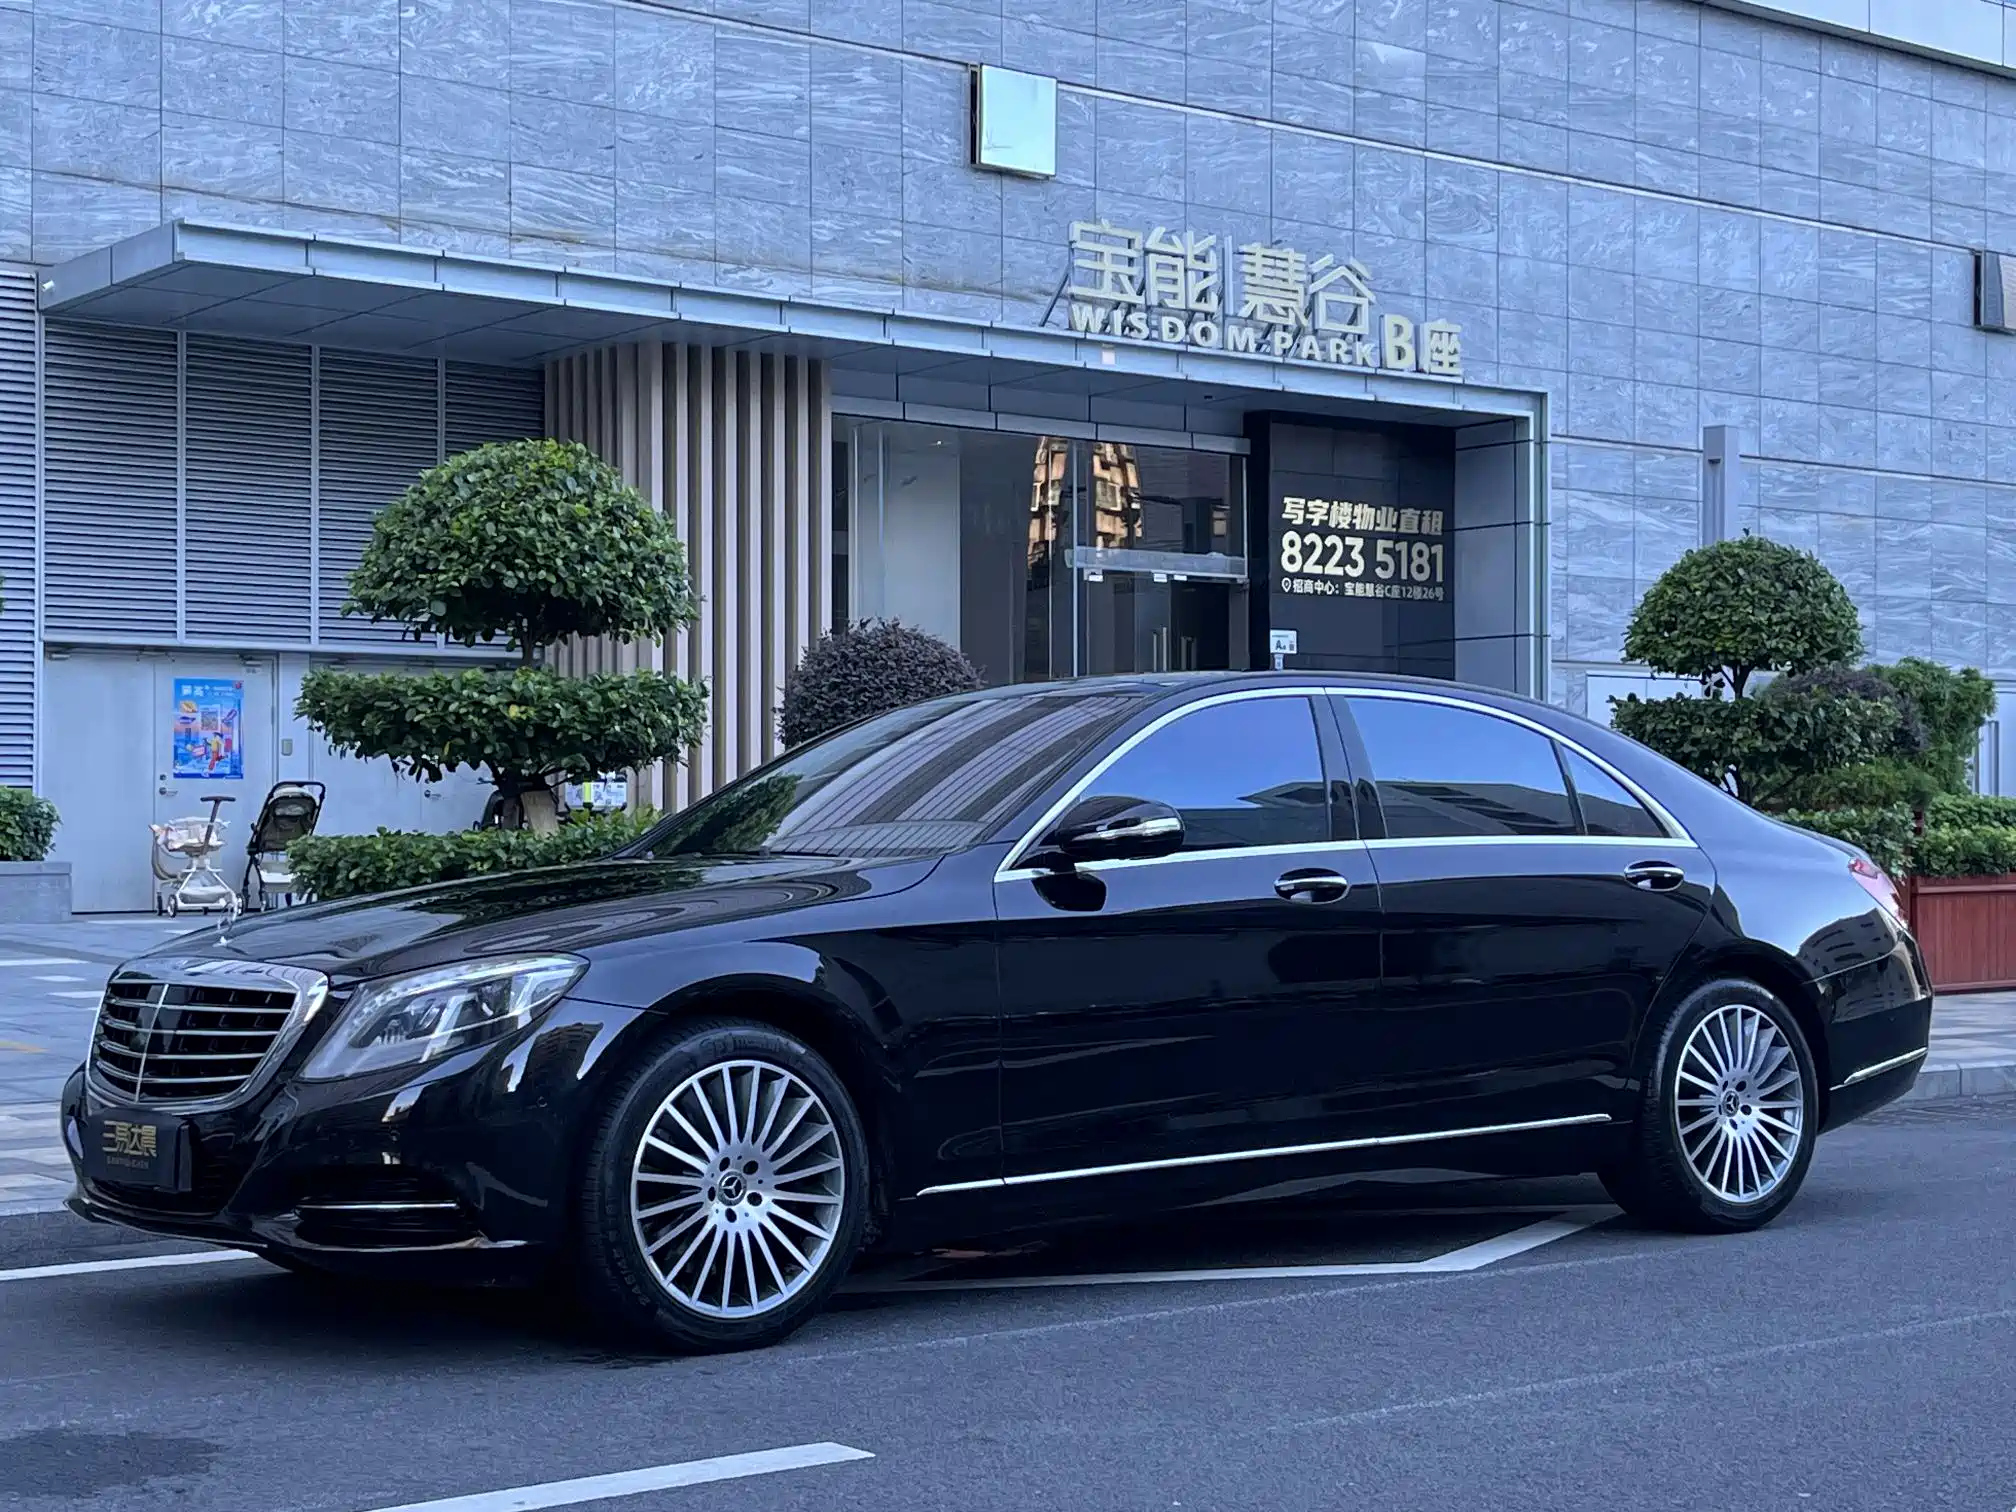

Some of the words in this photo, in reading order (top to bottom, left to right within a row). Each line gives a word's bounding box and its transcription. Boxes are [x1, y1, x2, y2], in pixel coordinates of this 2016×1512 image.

[1070, 303, 1256, 352] WISDOM
[1273, 331, 1379, 367] PARK
[1379, 313, 1463, 375] B座
[1282, 497, 1443, 535] 写字楼物业直租
[1281, 530, 1365, 578] 8223
[1375, 539, 1444, 583] 5181
